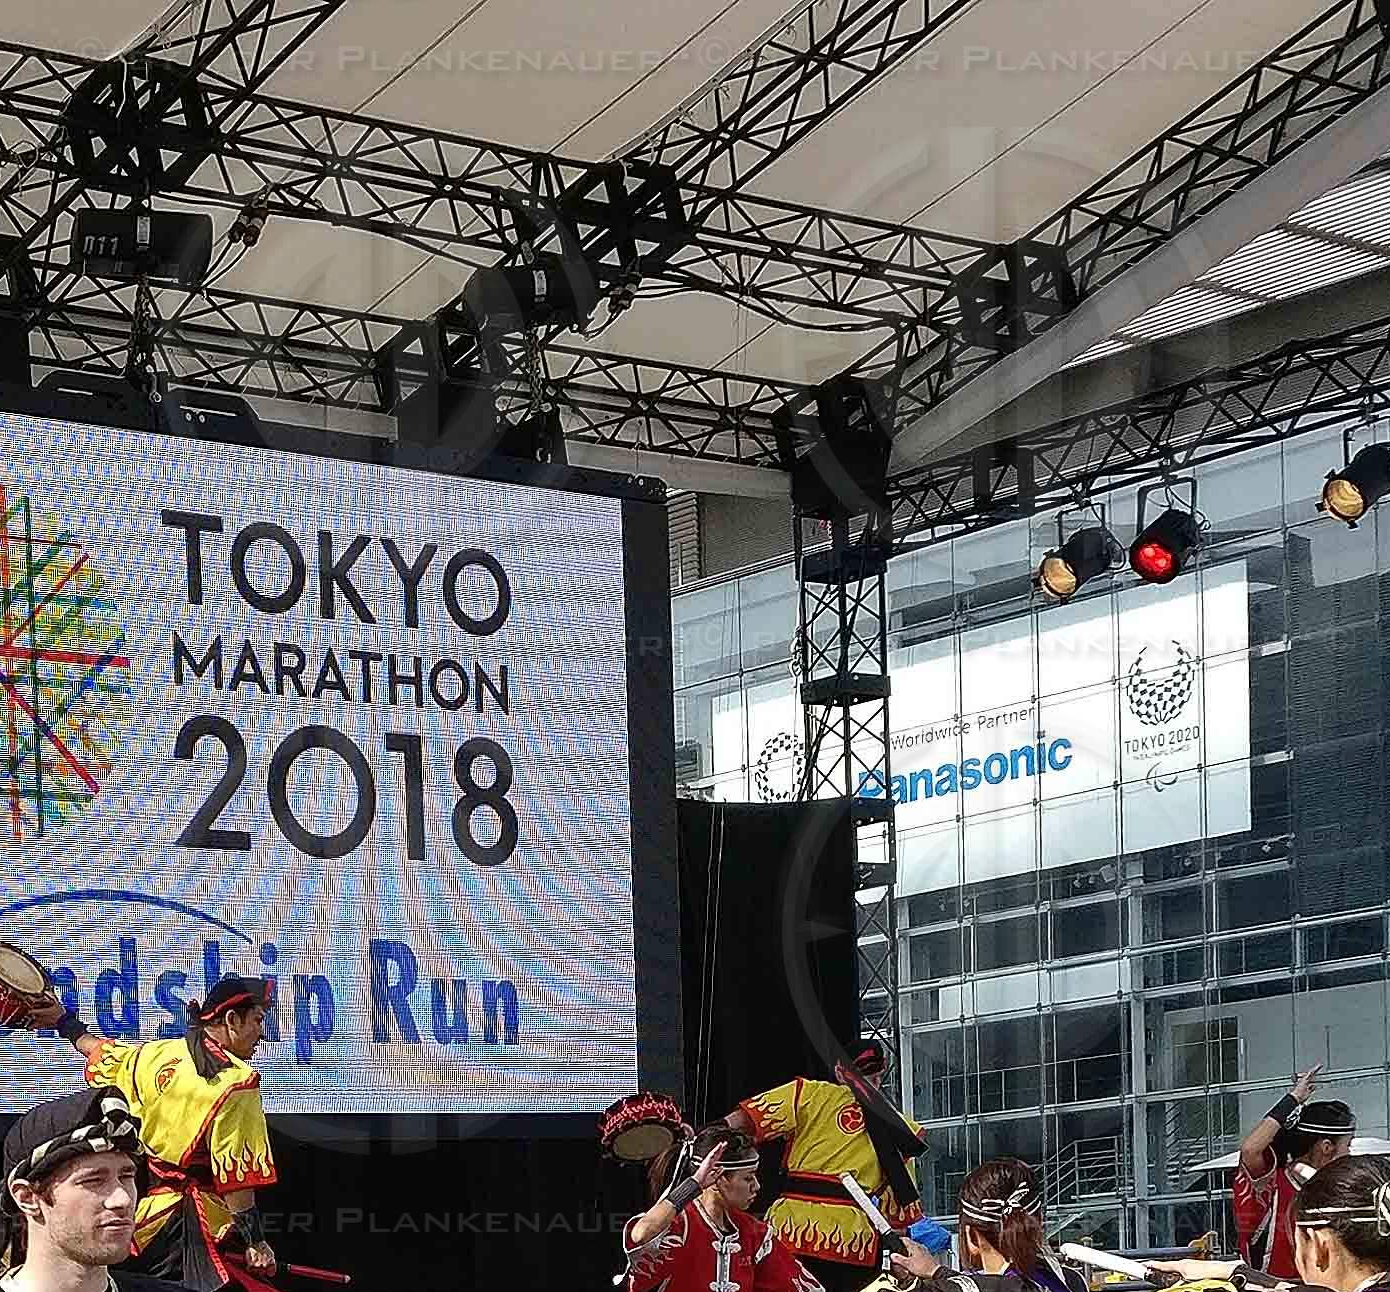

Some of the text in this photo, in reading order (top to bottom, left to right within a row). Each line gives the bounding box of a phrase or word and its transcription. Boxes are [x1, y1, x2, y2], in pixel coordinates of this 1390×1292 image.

[161, 508, 512, 637] TOKYO
[172, 629, 510, 716] MARATHON
[890, 706, 1035, 751] Worldwide Partner
[1124, 733, 1165, 756] TOKYO
[1168, 725, 1201, 745] 2020
[174, 714, 519, 867] 2018
[368, 936, 521, 1046] Run
